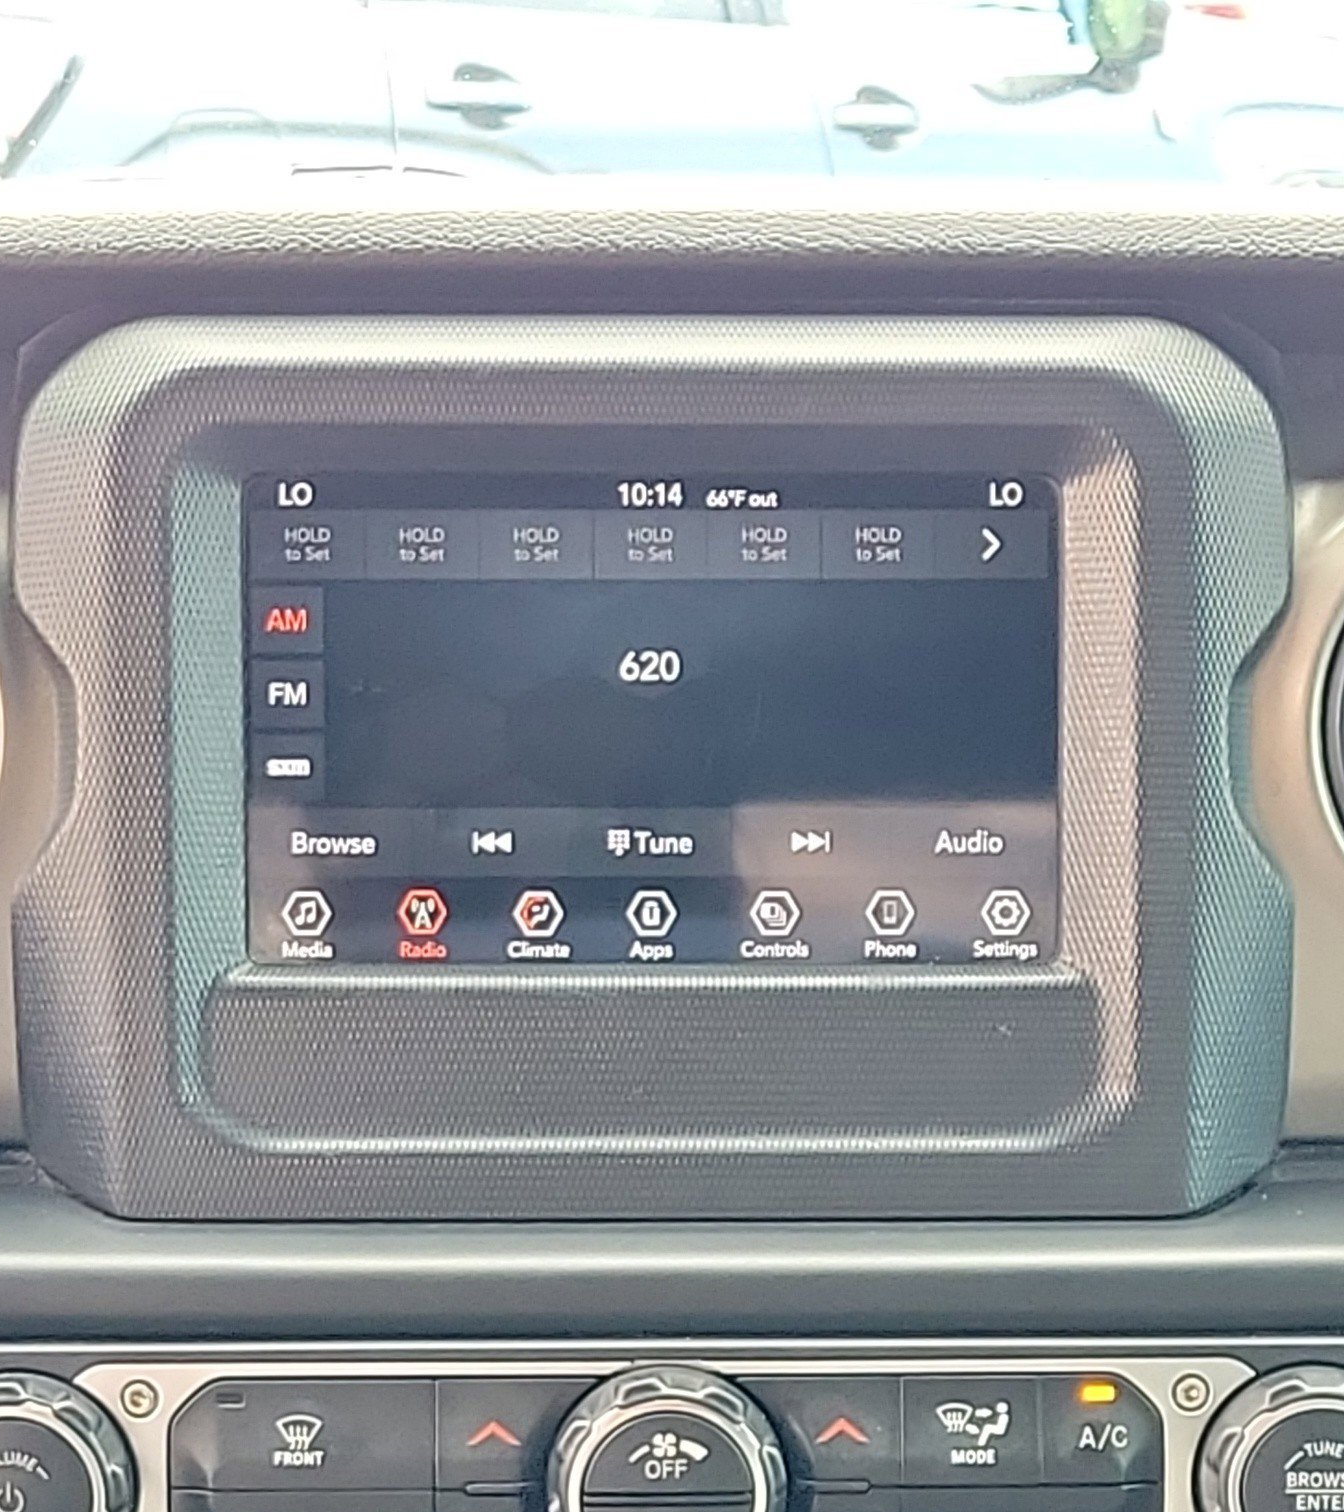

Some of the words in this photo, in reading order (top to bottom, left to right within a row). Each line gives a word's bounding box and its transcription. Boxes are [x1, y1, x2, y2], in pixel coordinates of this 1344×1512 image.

[277, 482, 313, 507] LO
[617, 481, 684, 508] 10:14
[748, 491, 778, 508] out
[989, 481, 1024, 507] LO
[284, 527, 331, 544] HOLD
[399, 527, 446, 544] HOLD
[513, 527, 560, 544] HOLD
[628, 527, 674, 544] HOLD
[742, 527, 787, 544] HOLD
[856, 527, 903, 544] HOLD
[285, 547, 301, 562] to
[304, 546, 331, 562] Set
[400, 547, 416, 562] to
[419, 546, 446, 562] Set
[514, 547, 530, 562] to
[533, 546, 560, 562] Set
[629, 547, 645, 562] to
[648, 546, 674, 562] Set
[743, 547, 759, 562] to
[762, 546, 787, 562] Set
[857, 547, 873, 562] to
[876, 546, 903, 562] Set
[266, 608, 307, 632] AM
[619, 651, 680, 682] 620
[268, 681, 307, 706] FM
[291, 832, 376, 855] Browse
[634, 832, 693, 855] Tune
[935, 831, 1004, 855] Audio
[282, 941, 334, 959] Media
[399, 941, 447, 959] Radio
[507, 940, 571, 959] Climate
[629, 941, 674, 961] Apps
[740, 940, 809, 959] Controls
[865, 941, 916, 958] Phone
[973, 940, 1038, 961] Settings
[1078, 1424, 1128, 1450] A/C
[273, 1450, 324, 1467] FRONT
[951, 1449, 996, 1465] MODE
[644, 1459, 688, 1480] OFF
